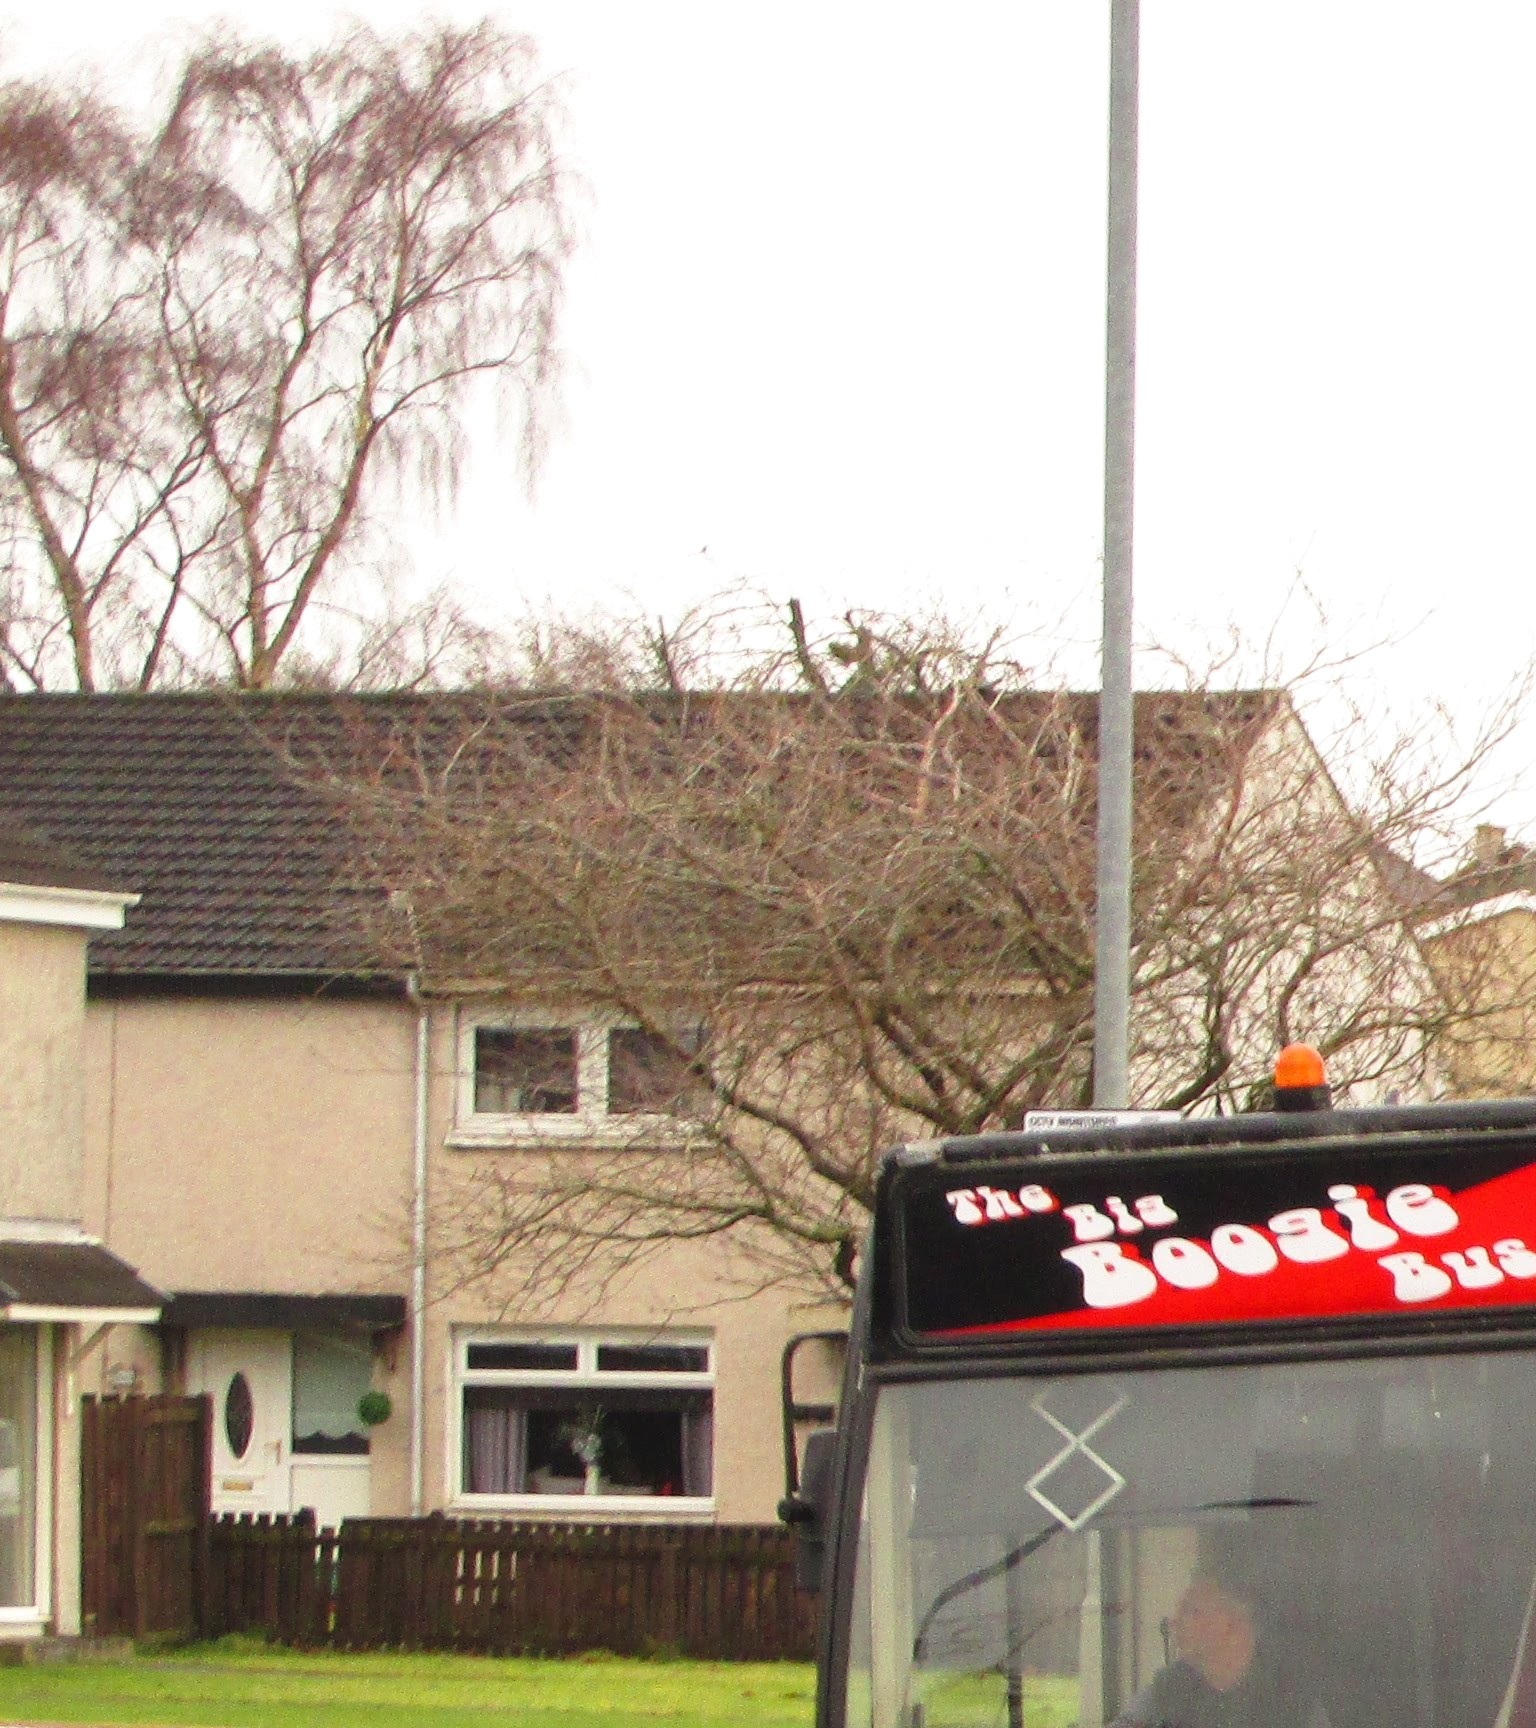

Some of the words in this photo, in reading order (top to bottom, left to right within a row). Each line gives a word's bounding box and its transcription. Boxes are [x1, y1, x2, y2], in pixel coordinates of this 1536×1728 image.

[946, 1184, 1053, 1225] The
[1063, 1195, 1179, 1242] Big
[1060, 1184, 1460, 1308] Boogie
